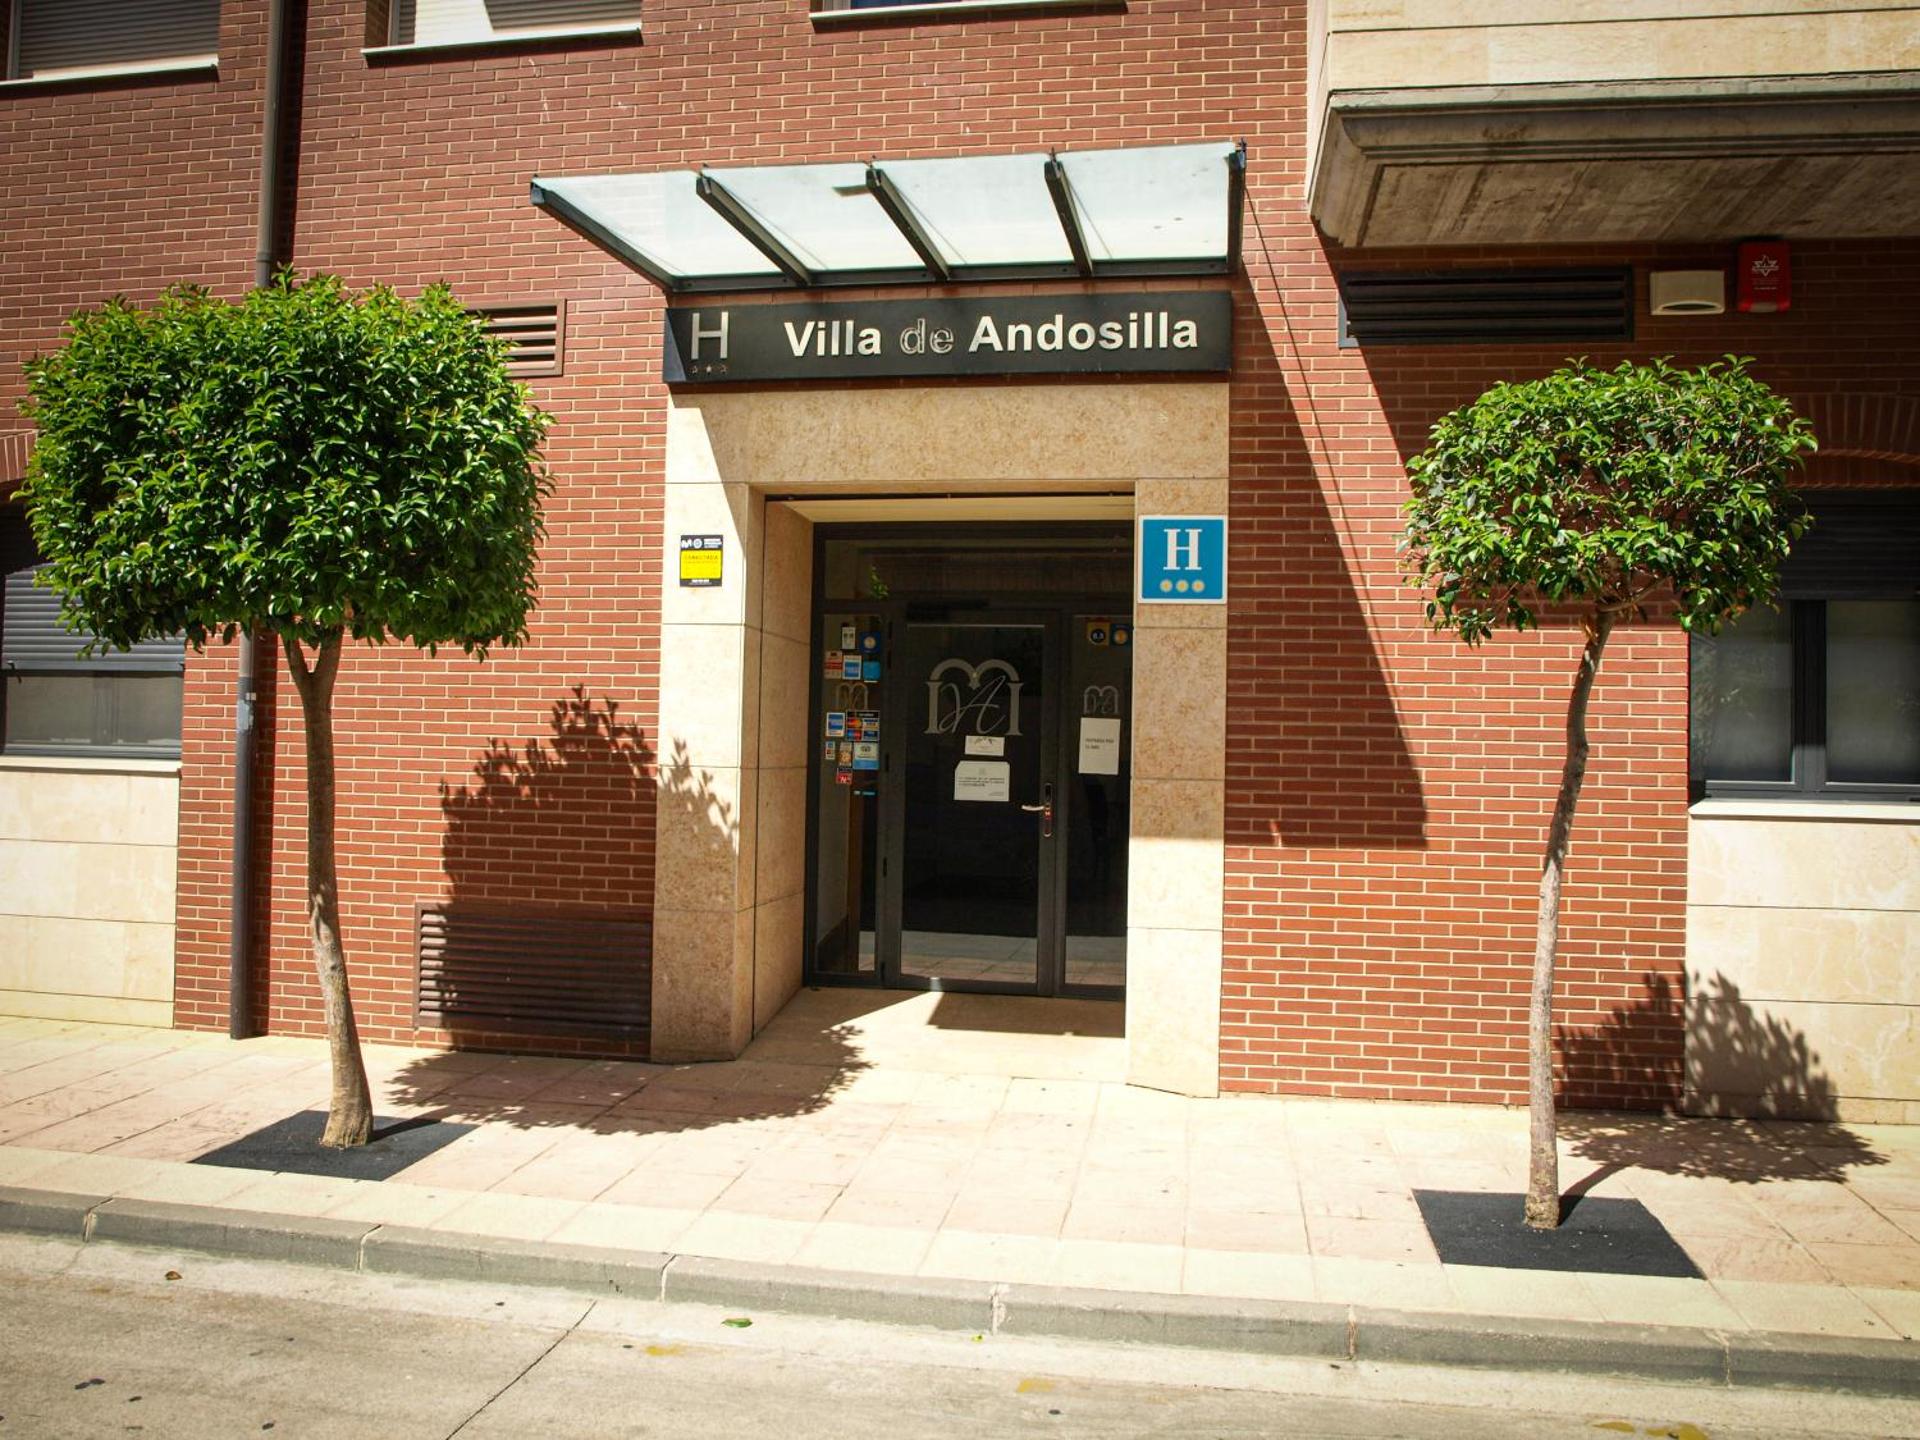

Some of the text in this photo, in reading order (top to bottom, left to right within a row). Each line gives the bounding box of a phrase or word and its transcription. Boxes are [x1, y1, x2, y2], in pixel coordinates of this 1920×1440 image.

[690, 311, 1199, 359] H Villa de Andosilla
[1163, 528, 1203, 570] H
